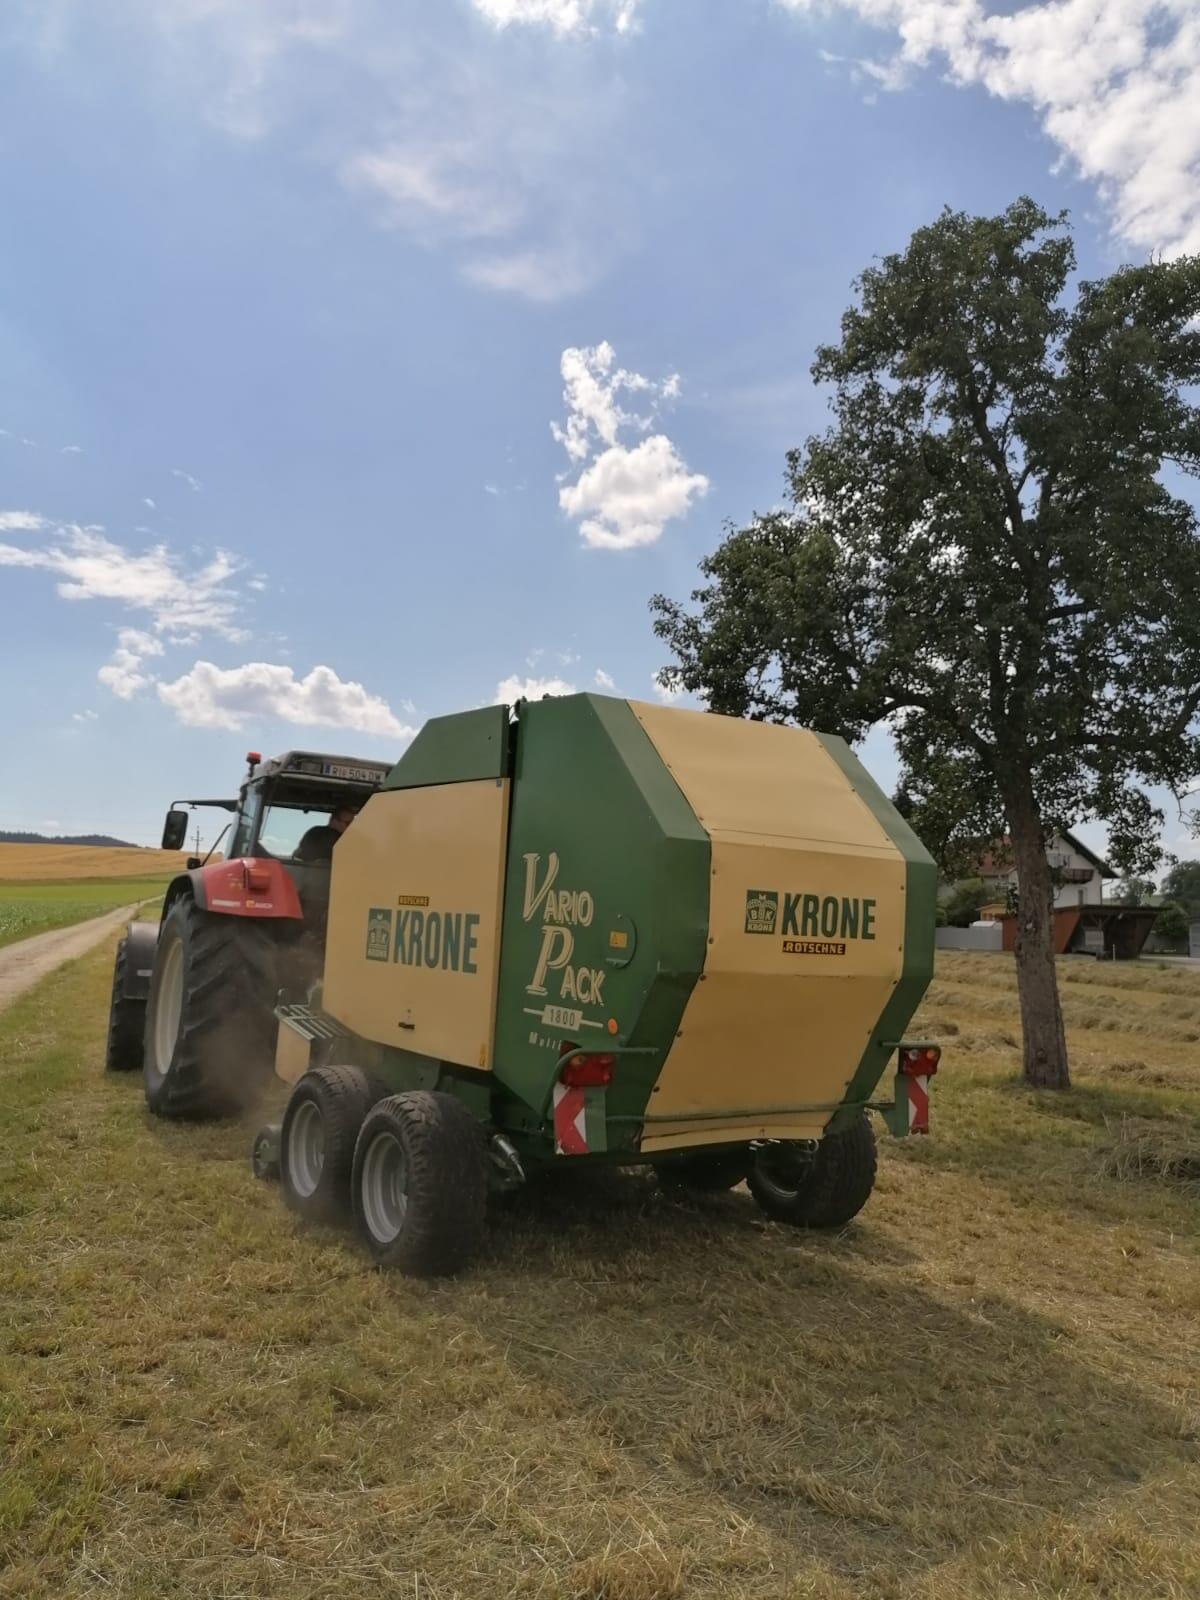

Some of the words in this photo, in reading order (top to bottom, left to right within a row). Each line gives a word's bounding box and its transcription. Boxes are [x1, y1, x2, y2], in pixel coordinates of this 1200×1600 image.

[781, 892, 876, 940] KRONE
[393, 909, 480, 974] KRONE
[549, 1008, 576, 1026] 1800
